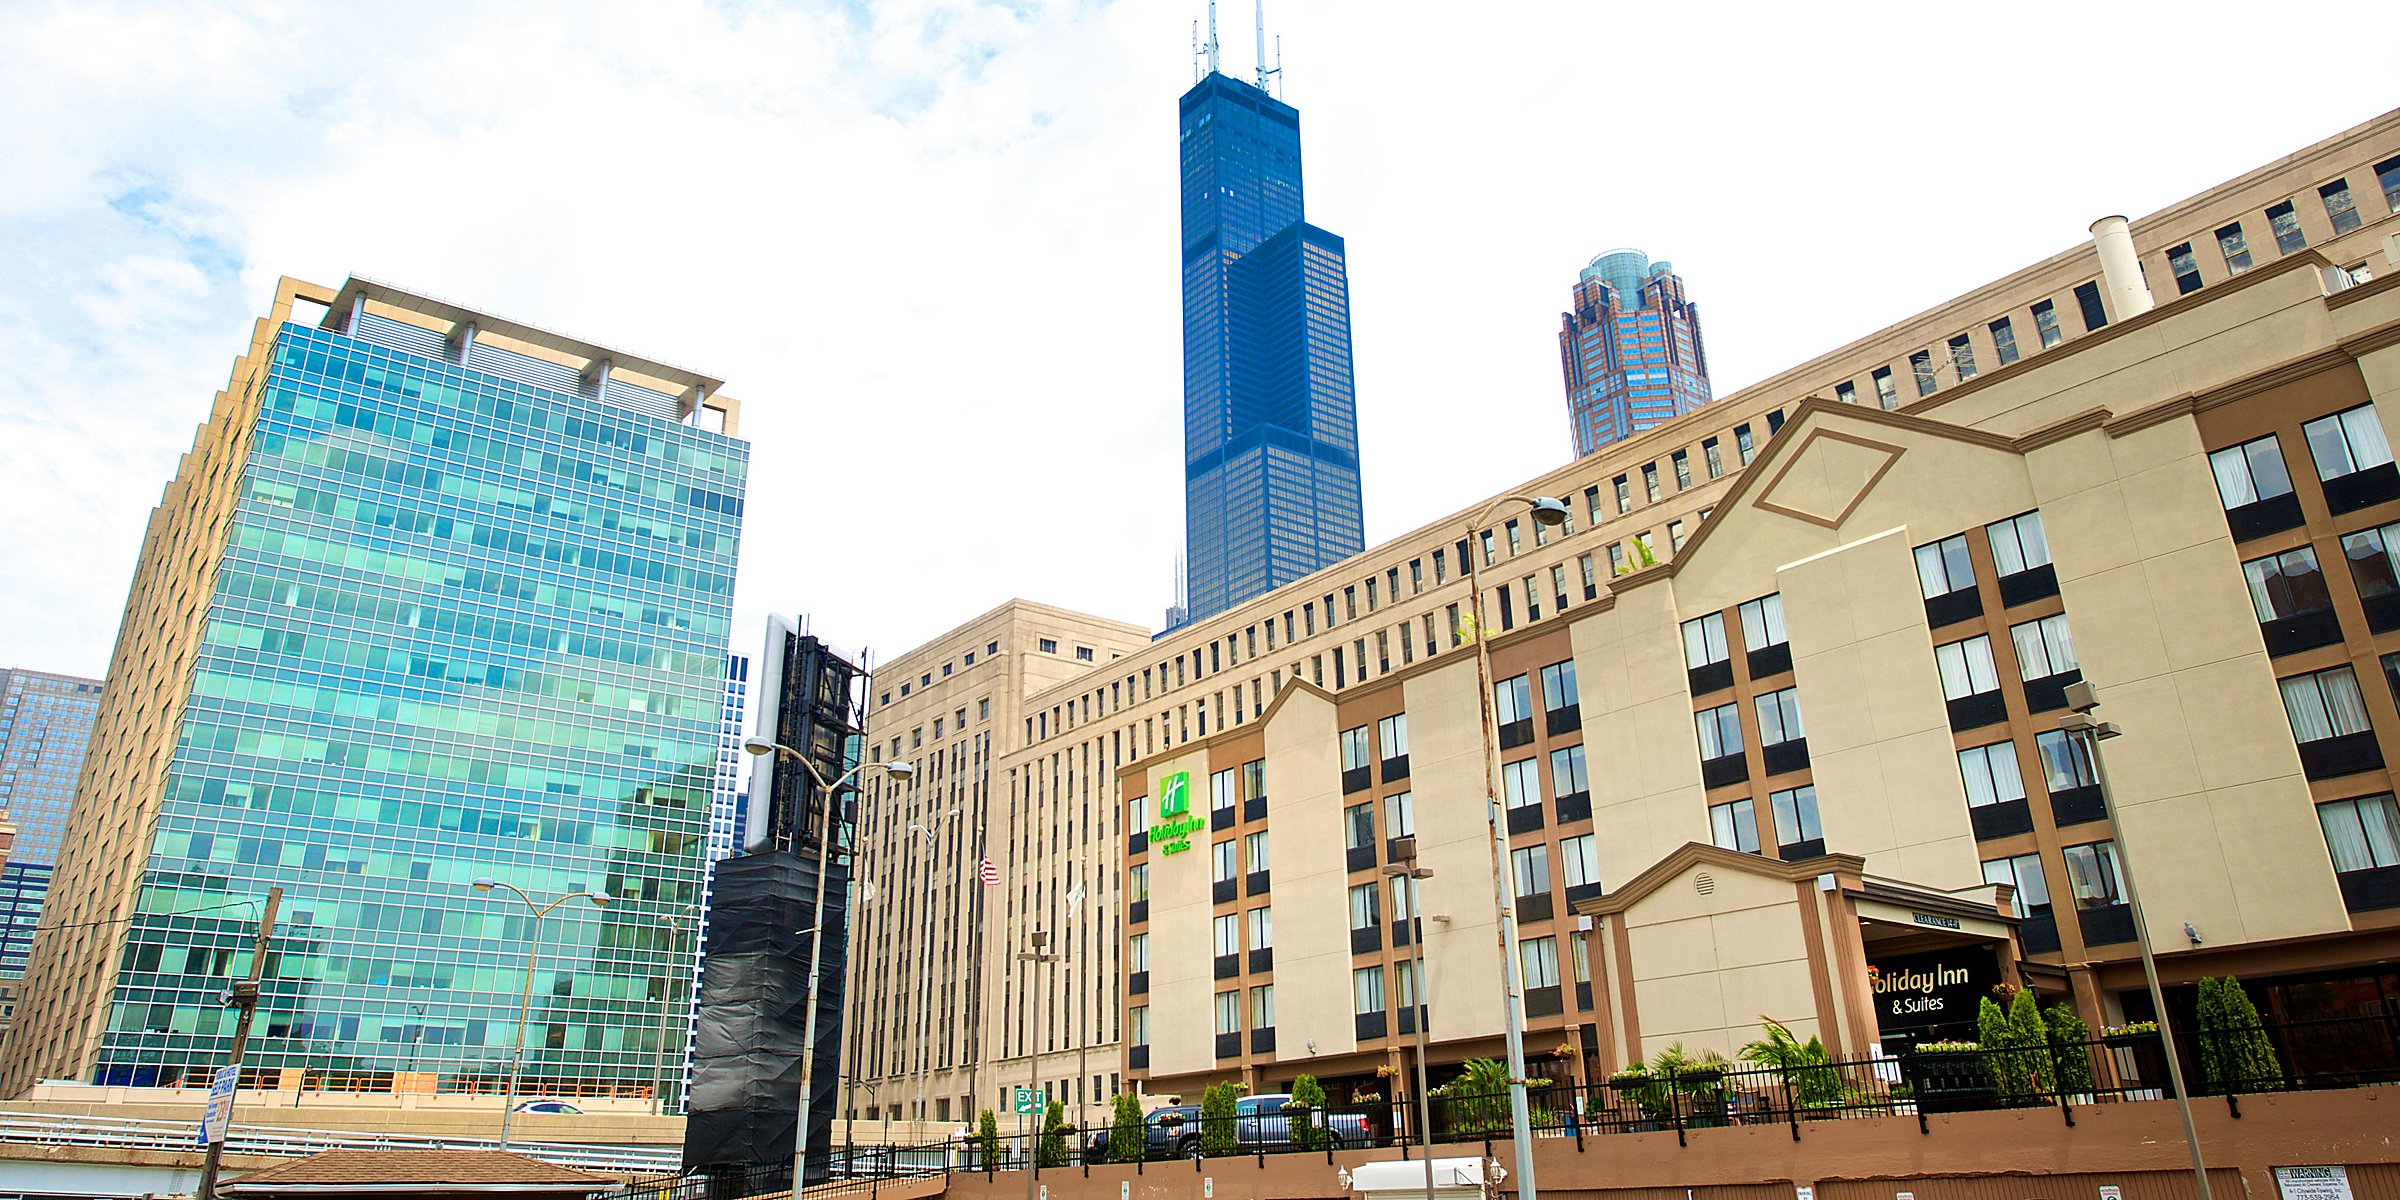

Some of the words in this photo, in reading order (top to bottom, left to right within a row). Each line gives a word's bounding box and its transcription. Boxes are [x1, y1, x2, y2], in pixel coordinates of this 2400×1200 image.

[1149, 820, 1187, 843] Holiday
[1187, 815, 1205, 832] Inn
[1162, 844, 1169, 856] &
[1169, 840, 1190, 854] Suites
[1913, 913, 1947, 927] CLEARANCE
[1872, 968, 1934, 994] oliday
[1938, 963, 1969, 986] Inn
[1892, 999, 1903, 1014] &
[1904, 996, 1944, 1013] Suites
[220, 1077, 235, 1094] PARK
[1018, 1091, 1042, 1102] EXT
[2290, 1168, 2331, 1178] WARNING
